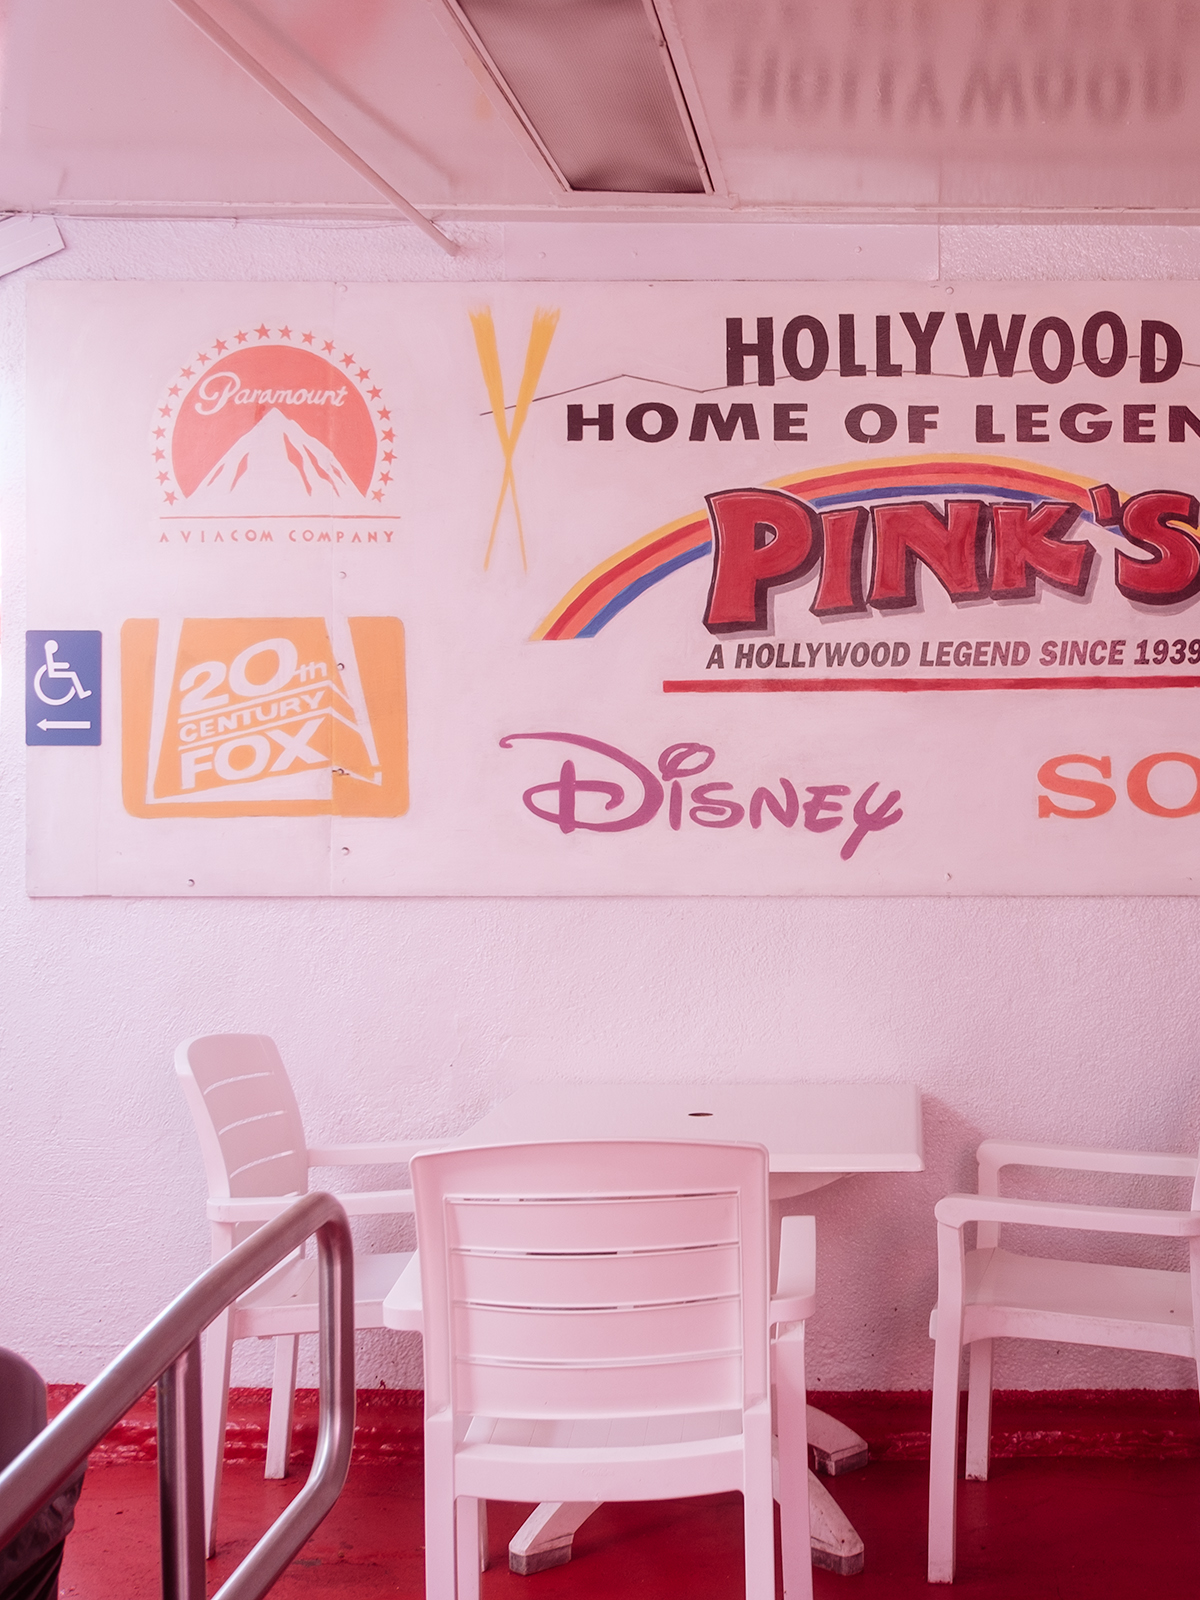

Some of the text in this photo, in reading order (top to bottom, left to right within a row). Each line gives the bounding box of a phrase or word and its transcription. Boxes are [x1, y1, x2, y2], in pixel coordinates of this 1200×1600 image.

[724, 311, 1184, 387] HOLLYWOOD
[194, 371, 348, 416] Paramount
[566, 403, 807, 443] HOME
[844, 404, 939, 444] OF
[159, 530, 395, 544] A VIACOM COMPANY
[705, 643, 725, 670] A
[734, 641, 911, 669] HOLLYWOOD
[919, 640, 1031, 668] LEGEND
[1039, 639, 1125, 667] SINCE
[179, 690, 326, 742] CENTURY
[180, 717, 330, 790] FOX
